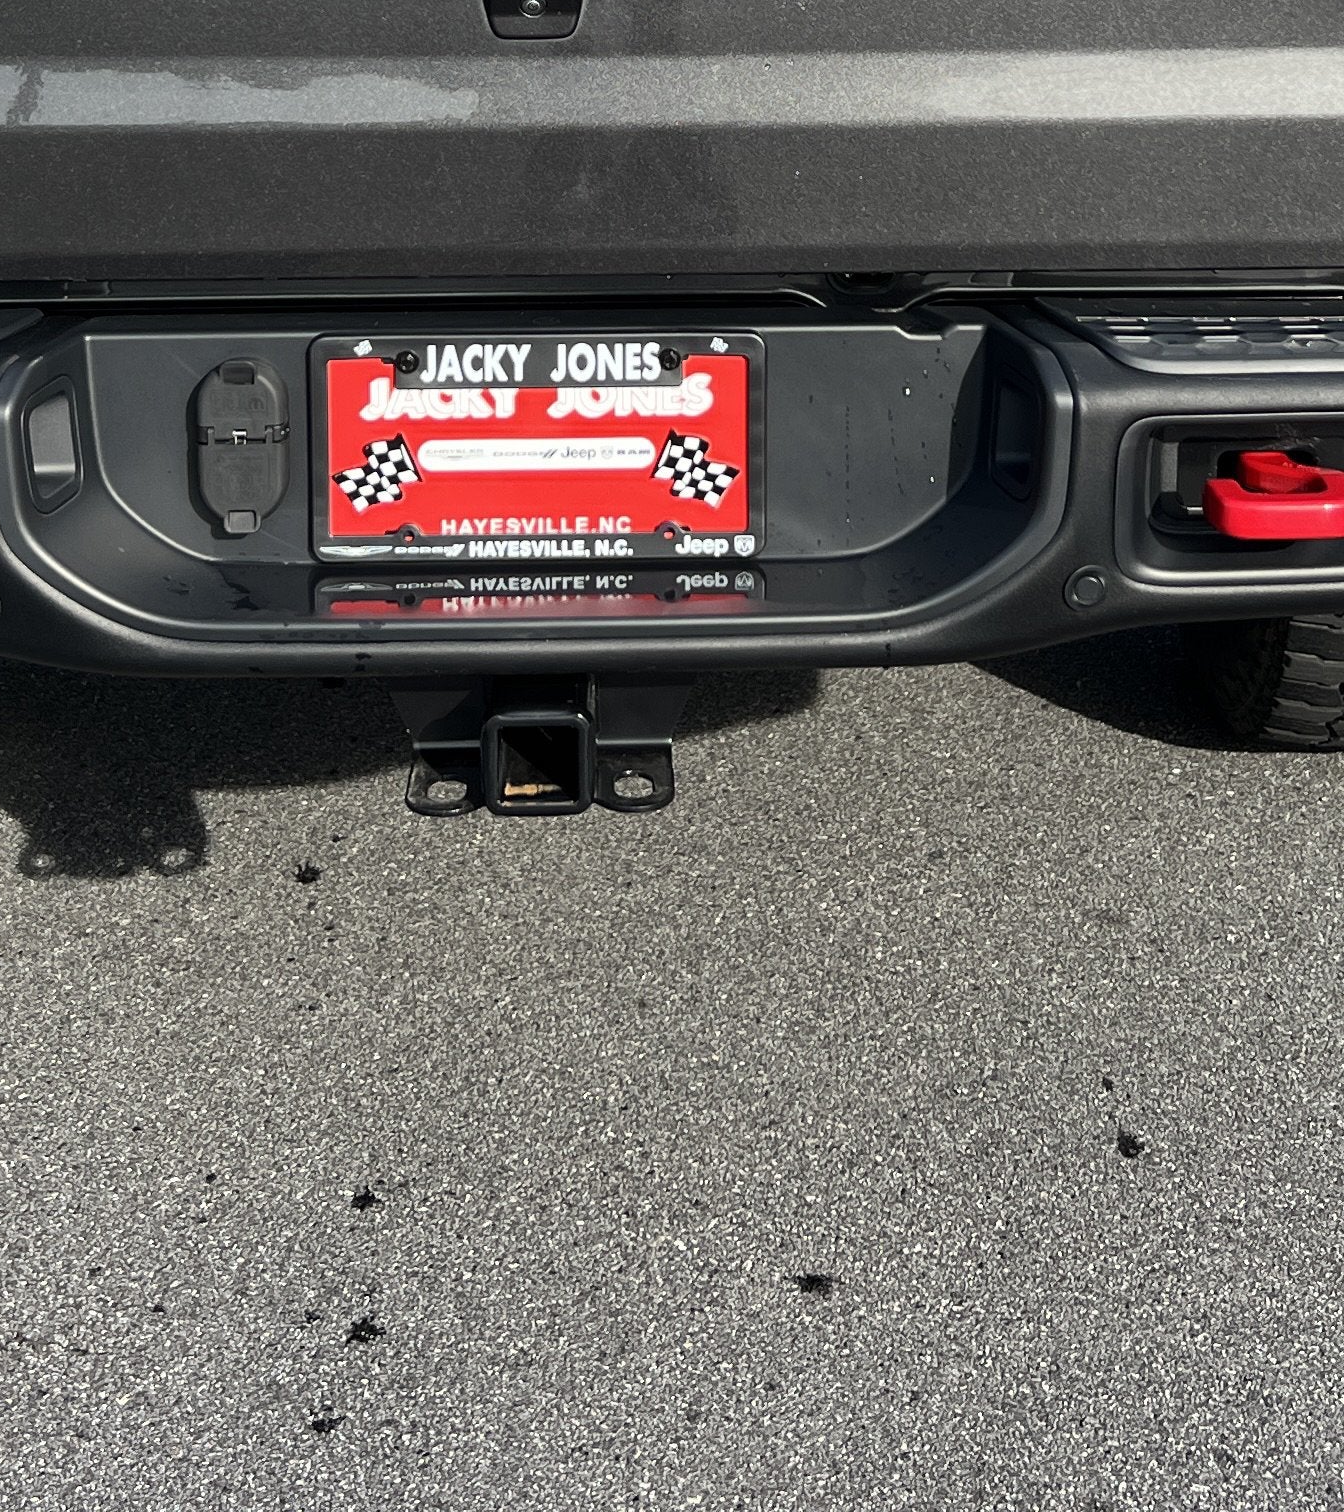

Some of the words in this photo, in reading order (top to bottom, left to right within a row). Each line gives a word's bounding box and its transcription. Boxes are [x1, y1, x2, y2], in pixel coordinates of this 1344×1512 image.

[420, 343, 532, 383] JACKY
[550, 342, 662, 382] JONES
[359, 376, 521, 420] JACKY
[546, 372, 714, 419] JONES
[560, 446, 597, 460] Jeep
[469, 539, 591, 558] HAYESVILLE,
[595, 539, 634, 556] N.C.
[675, 534, 729, 558] Jeep
